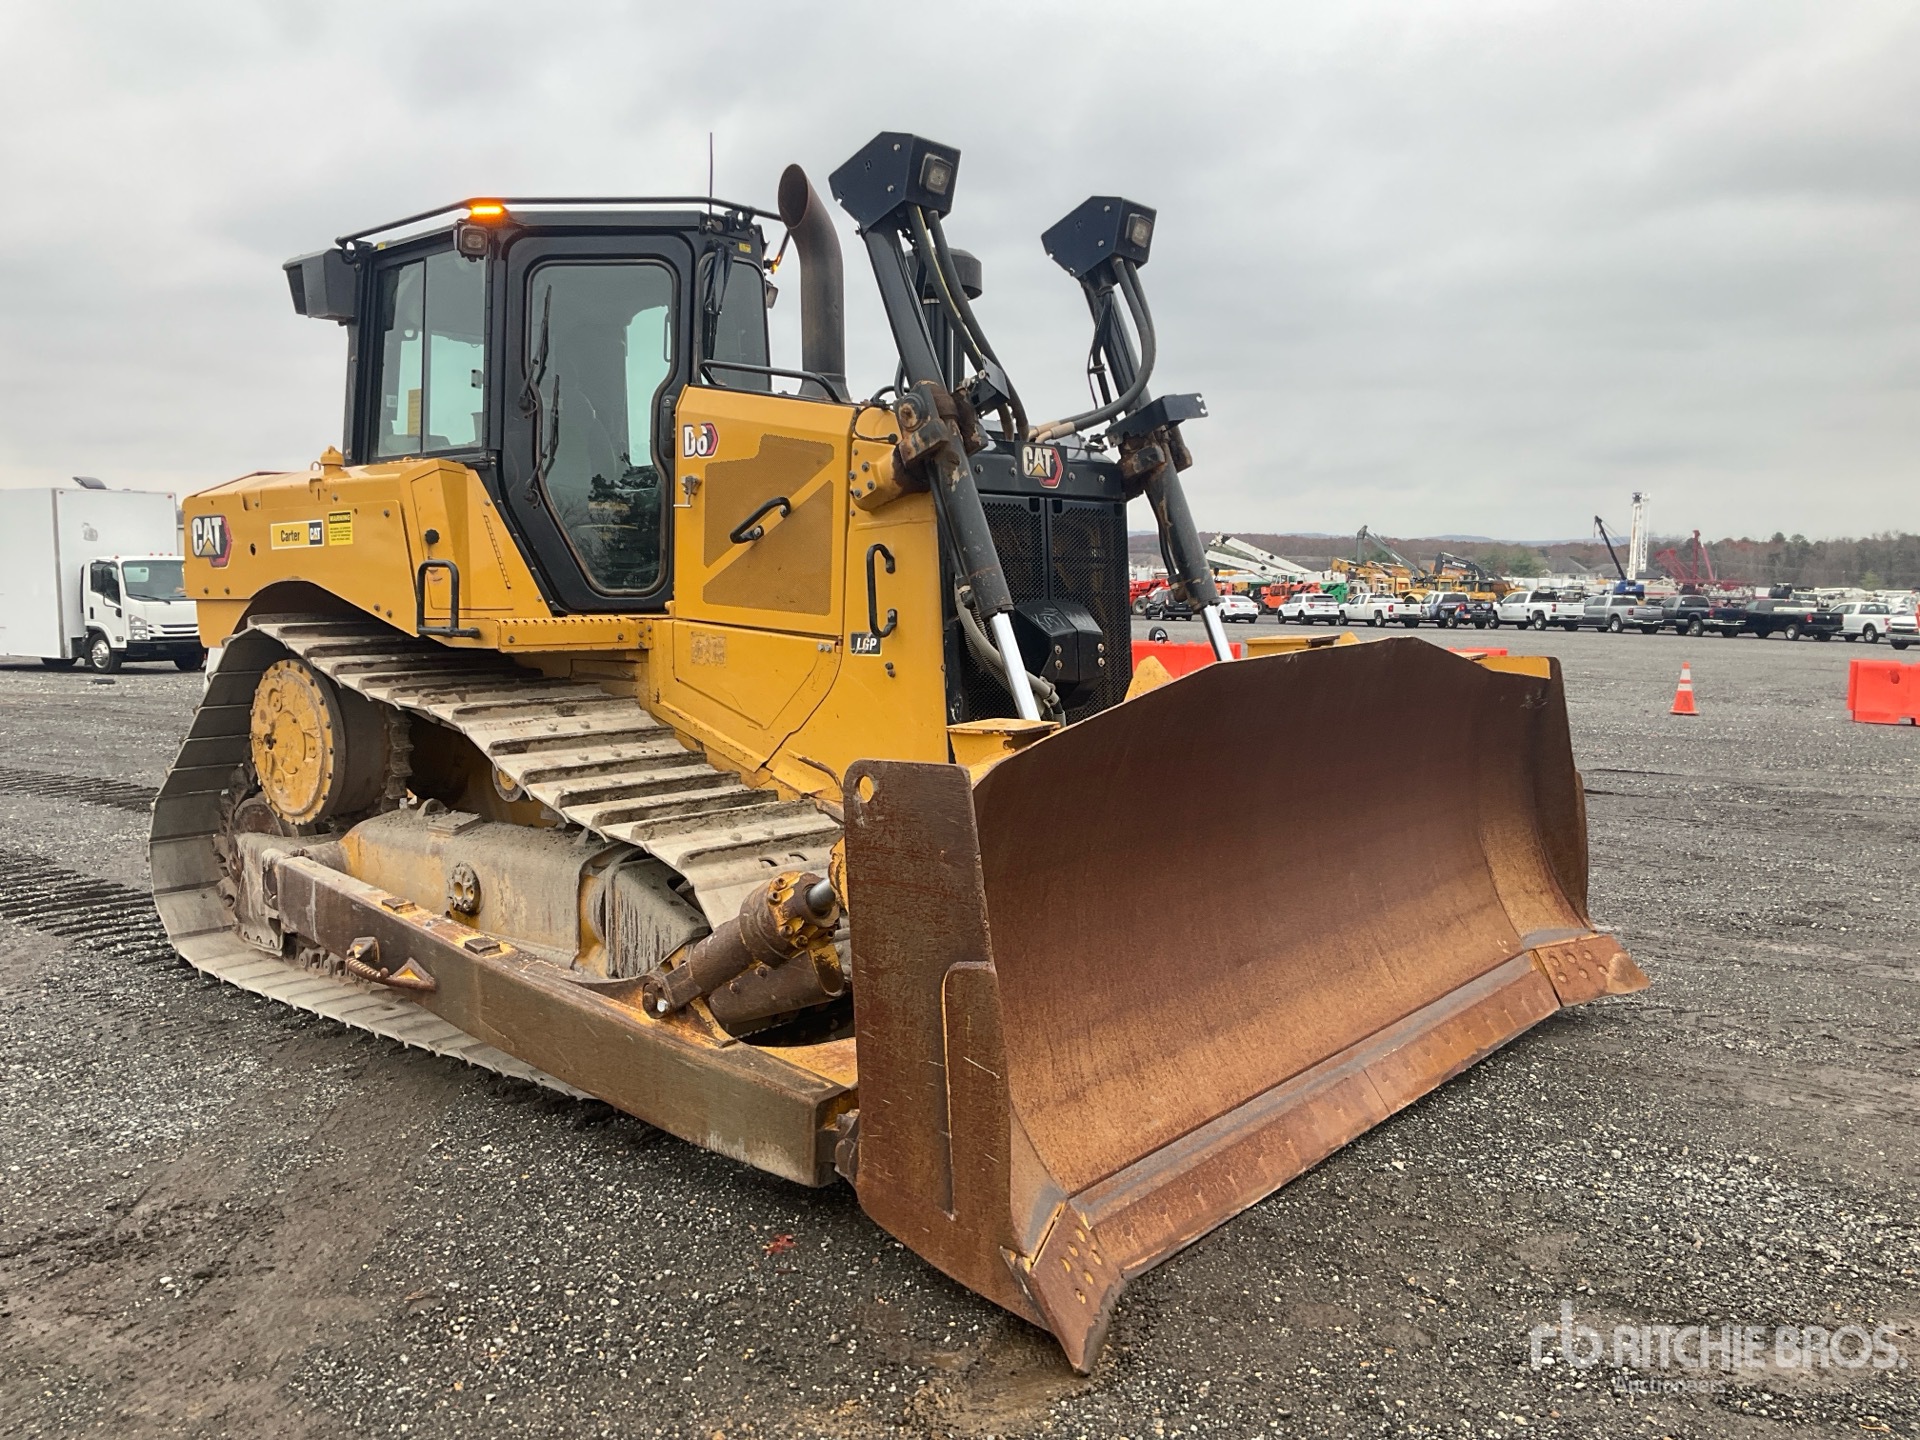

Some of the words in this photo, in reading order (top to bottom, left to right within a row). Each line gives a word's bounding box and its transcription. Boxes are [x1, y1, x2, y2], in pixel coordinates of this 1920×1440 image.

[684, 425, 708, 456] D6
[1022, 446, 1053, 477] CAT
[192, 516, 222, 557] CAT
[280, 529, 300, 542] Carter
[309, 527, 321, 541] CAT
[857, 637, 877, 651] LGP
